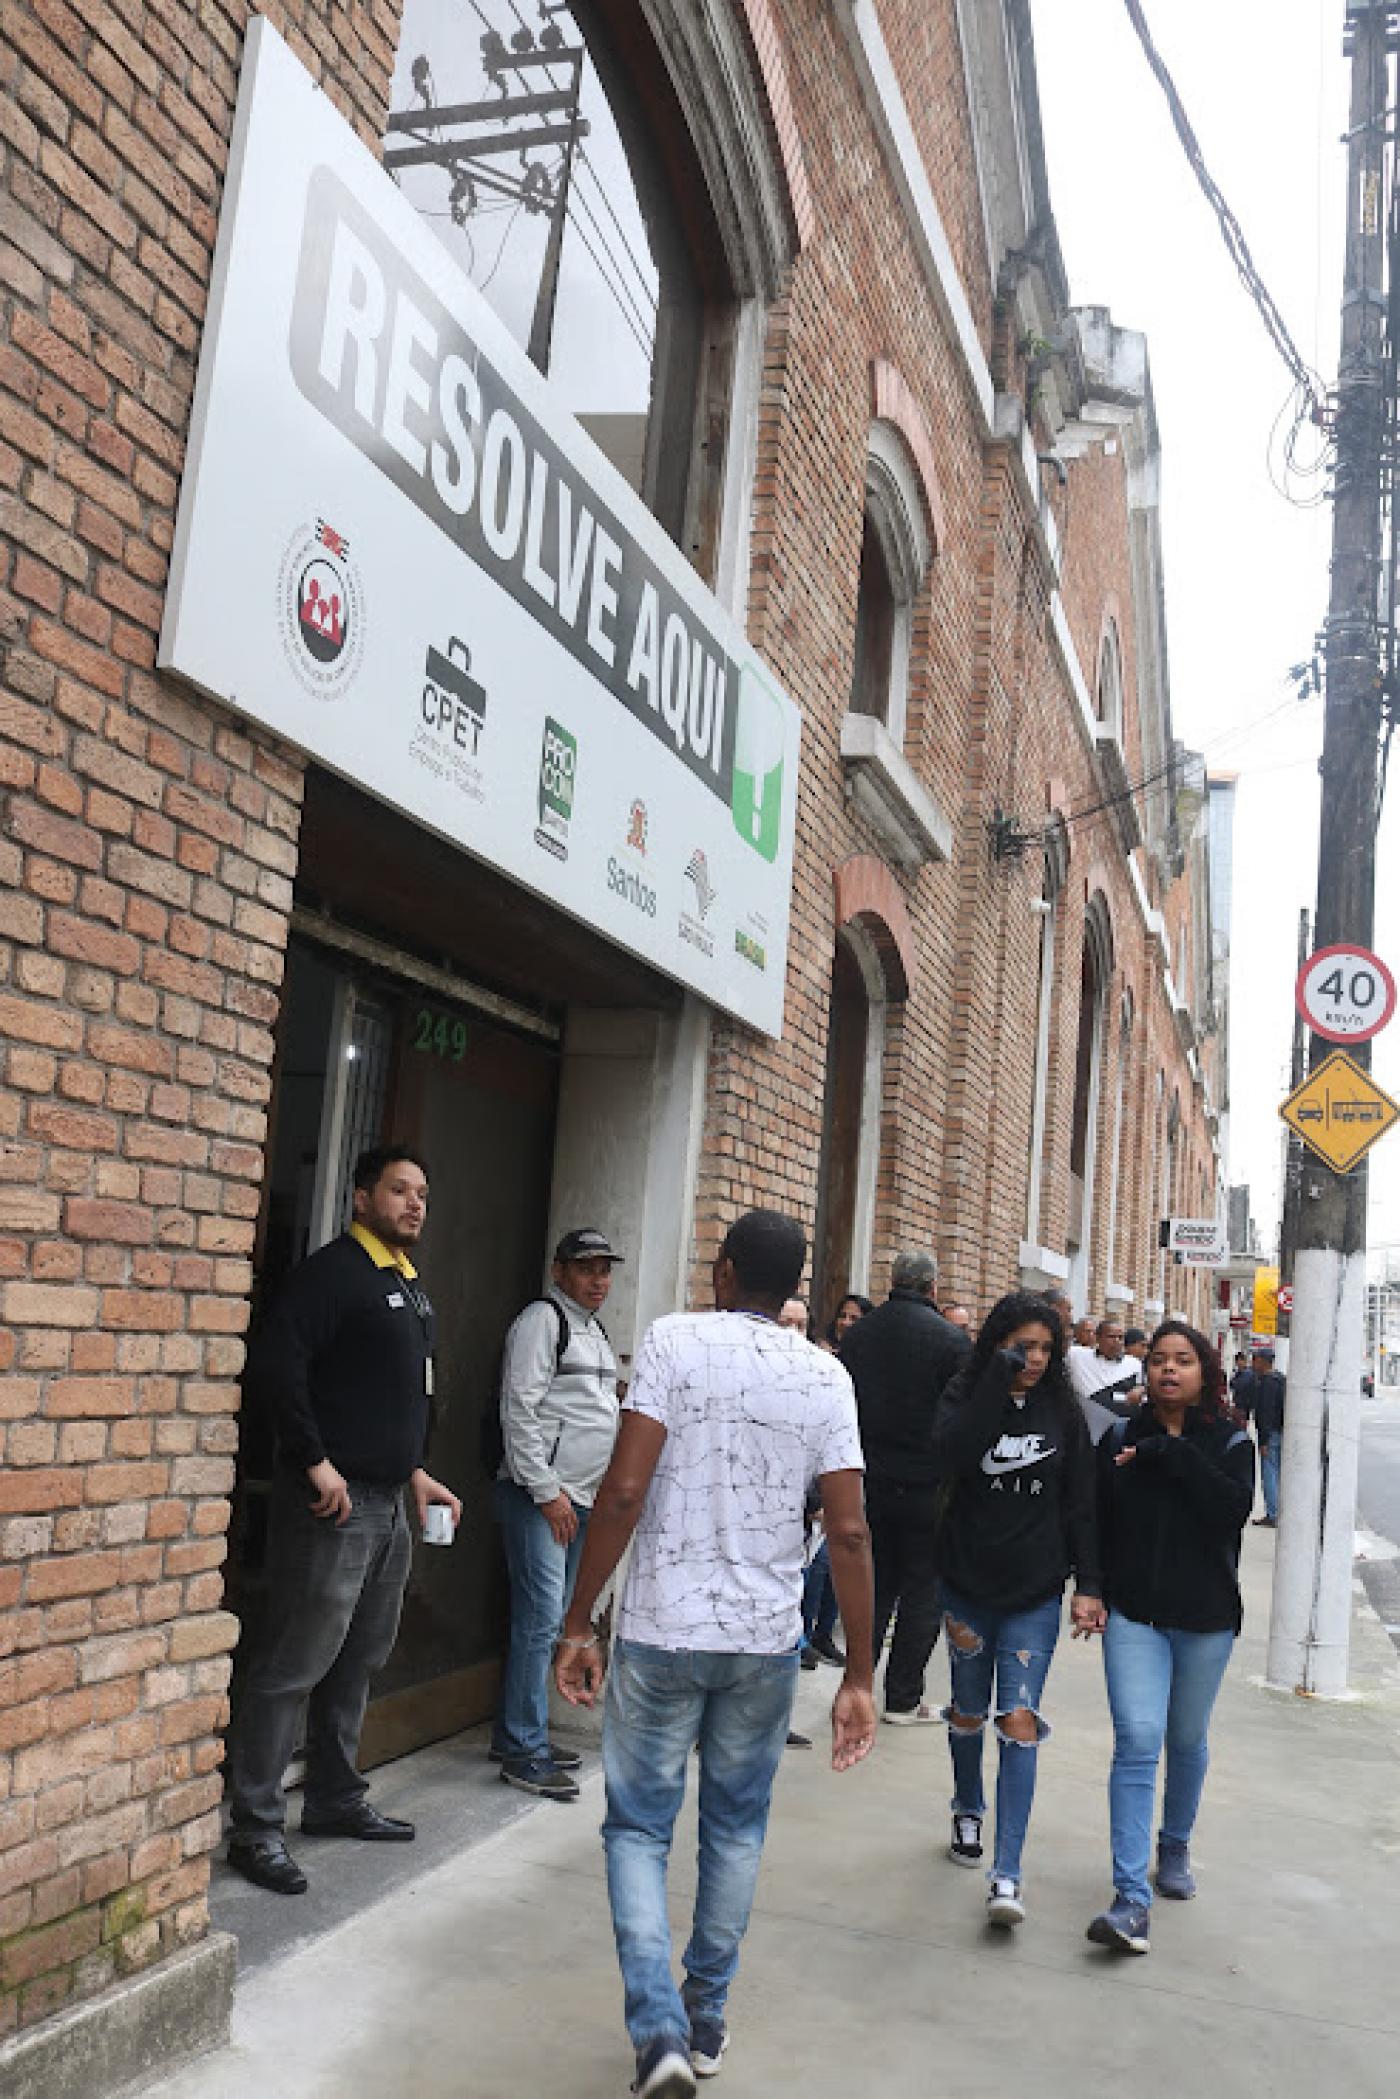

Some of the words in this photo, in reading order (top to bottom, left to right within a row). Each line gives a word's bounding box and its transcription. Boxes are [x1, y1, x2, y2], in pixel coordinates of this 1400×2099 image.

[319, 213, 624, 669] RESOLVE
[627, 585, 727, 774] AQUI
[421, 683, 484, 756] CPET
[544, 729, 572, 775] PRO
[607, 855, 657, 918] Santos
[1317, 968, 1376, 1008] 40
[414, 1008, 467, 1062] 249
[990, 1476, 1043, 1494] AIR
